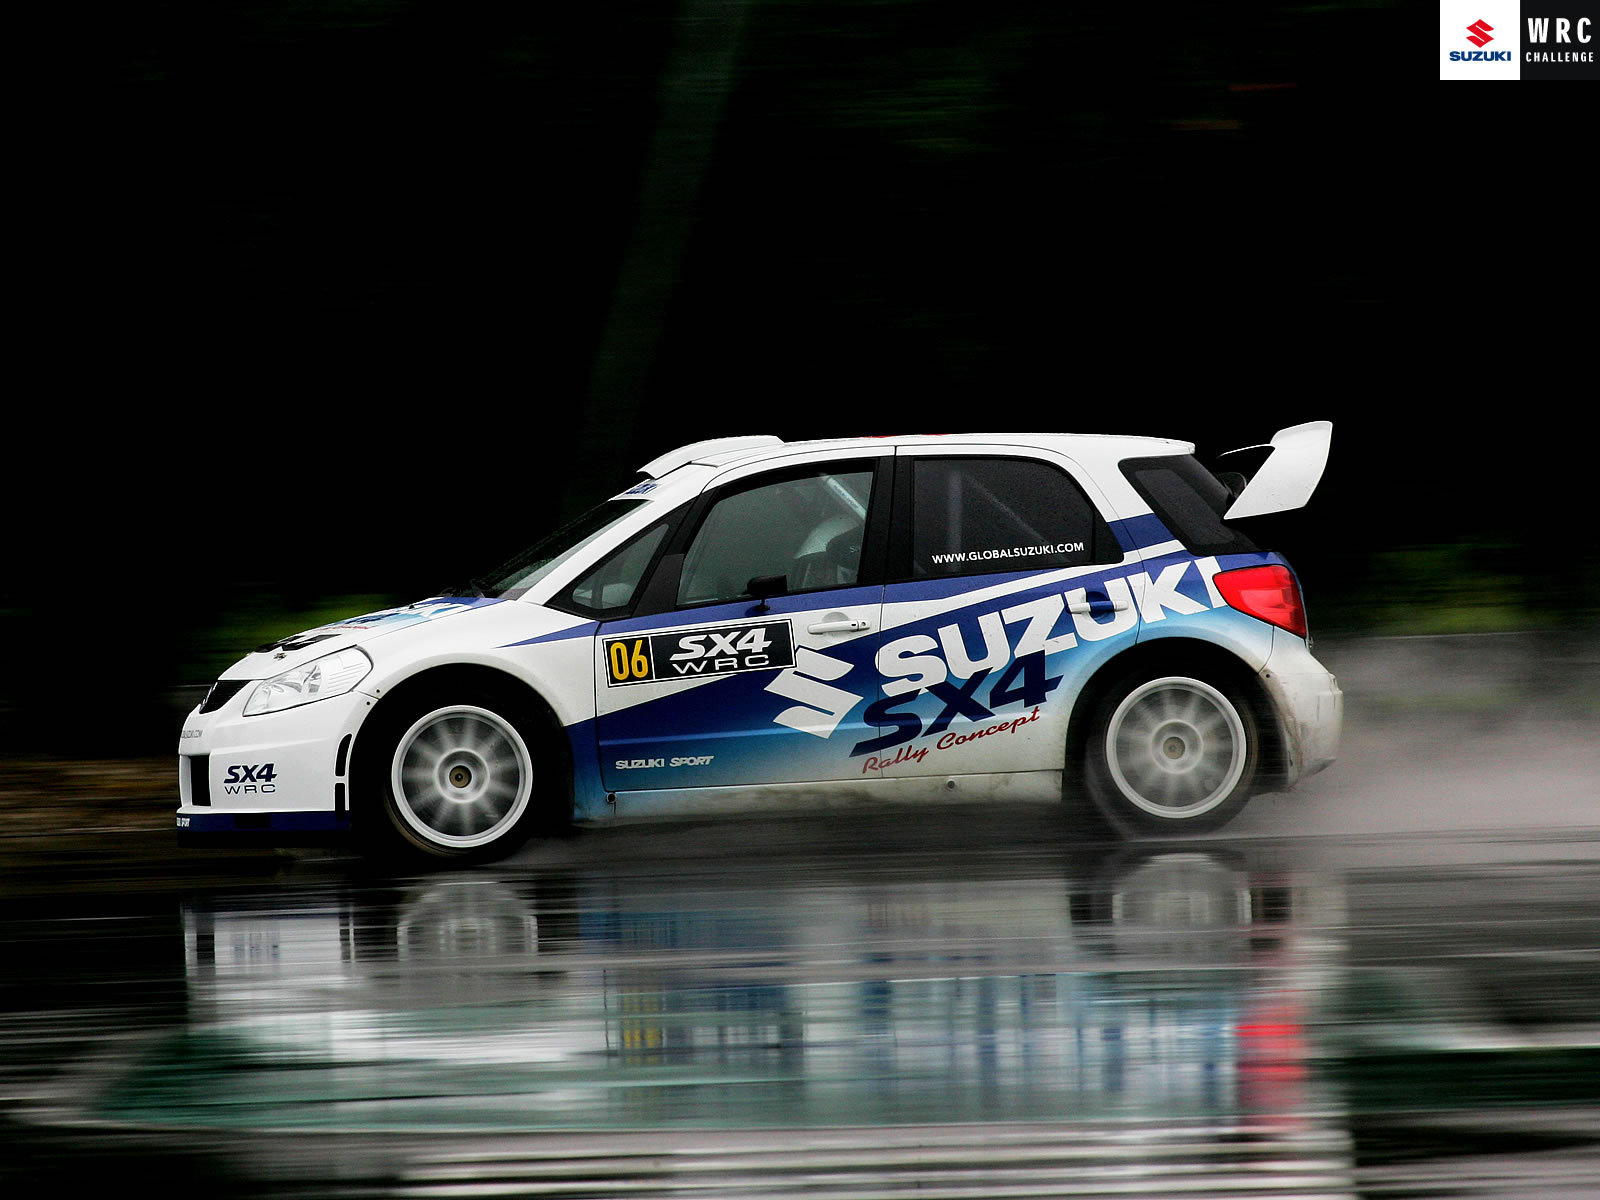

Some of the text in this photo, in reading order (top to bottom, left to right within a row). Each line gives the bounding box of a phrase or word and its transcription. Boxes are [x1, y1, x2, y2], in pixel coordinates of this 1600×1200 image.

[931, 542, 1084, 564] WWW.GLOBALSUZUKI.COM
[875, 556, 1227, 696] SUZUKI
[669, 627, 772, 661] SX4
[610, 639, 649, 681] 06
[672, 654, 770, 674] WRC
[849, 650, 1064, 758] SX4
[862, 705, 1041, 774] Rally Concept
[224, 763, 277, 784] SX4
[615, 755, 715, 770] SUZUKI SPORT
[224, 784, 276, 795] WRC
